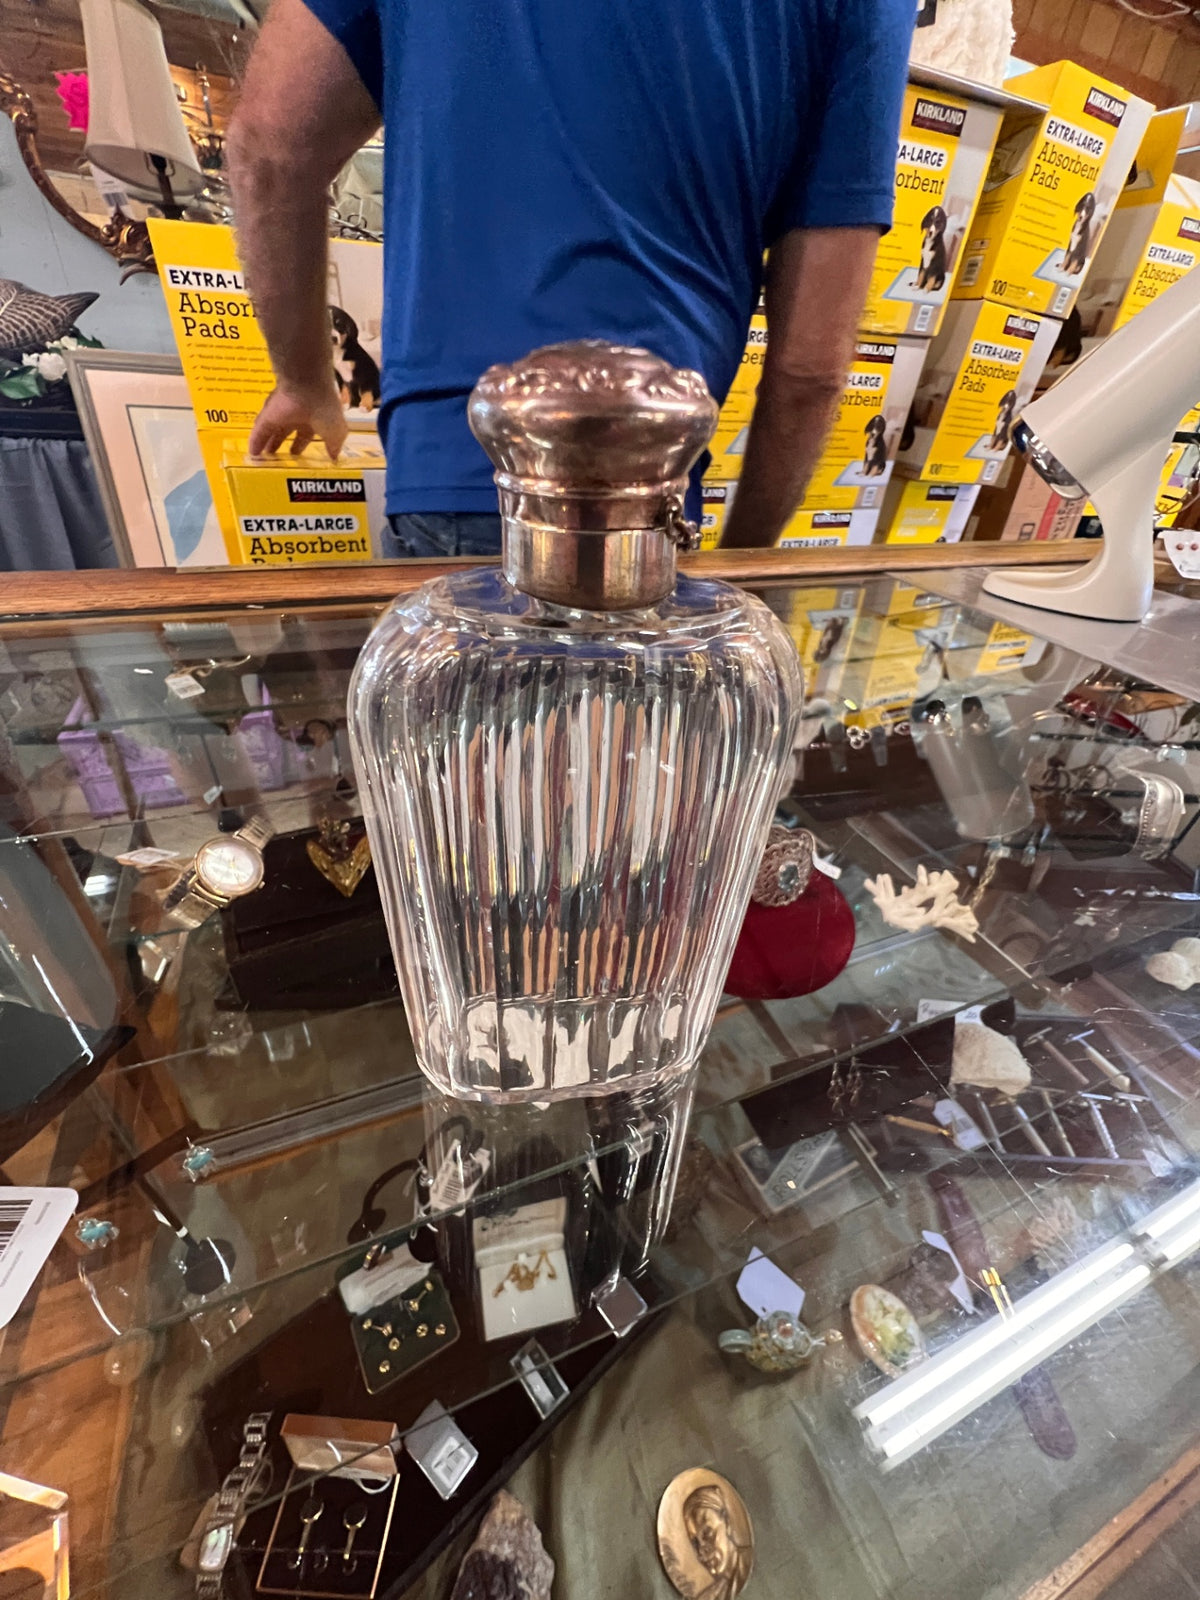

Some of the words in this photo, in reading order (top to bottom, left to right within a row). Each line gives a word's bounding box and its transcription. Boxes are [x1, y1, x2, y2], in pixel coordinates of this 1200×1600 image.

[1088, 89, 1124, 118] KIRKLAND
[916, 102, 964, 126] KIRKLAND
[1046, 120, 1104, 155] EXTRA-LARGE
[898, 145, 945, 167] A-LARGE
[1037, 142, 1100, 182] Absorbent
[895, 170, 945, 195] orbent
[1029, 163, 1060, 190] Pads
[169, 269, 243, 290] EXTRA-L
[1133, 280, 1158, 299] Pads
[179, 292, 257, 318] Absor
[181, 316, 240, 340] Pads
[972, 343, 1022, 362] EXTRA-LARGE
[848, 375, 882, 388] -LARGE
[959, 375, 986, 393] Pads
[840, 391, 883, 407] orbent
[205, 409, 229, 424] 100
[292, 480, 362, 494] KIRKLAND
[702, 488, 725, 498] LAND
[243, 518, 355, 532] EXTRA-LARGE
[249, 537, 368, 555] Absorbent
